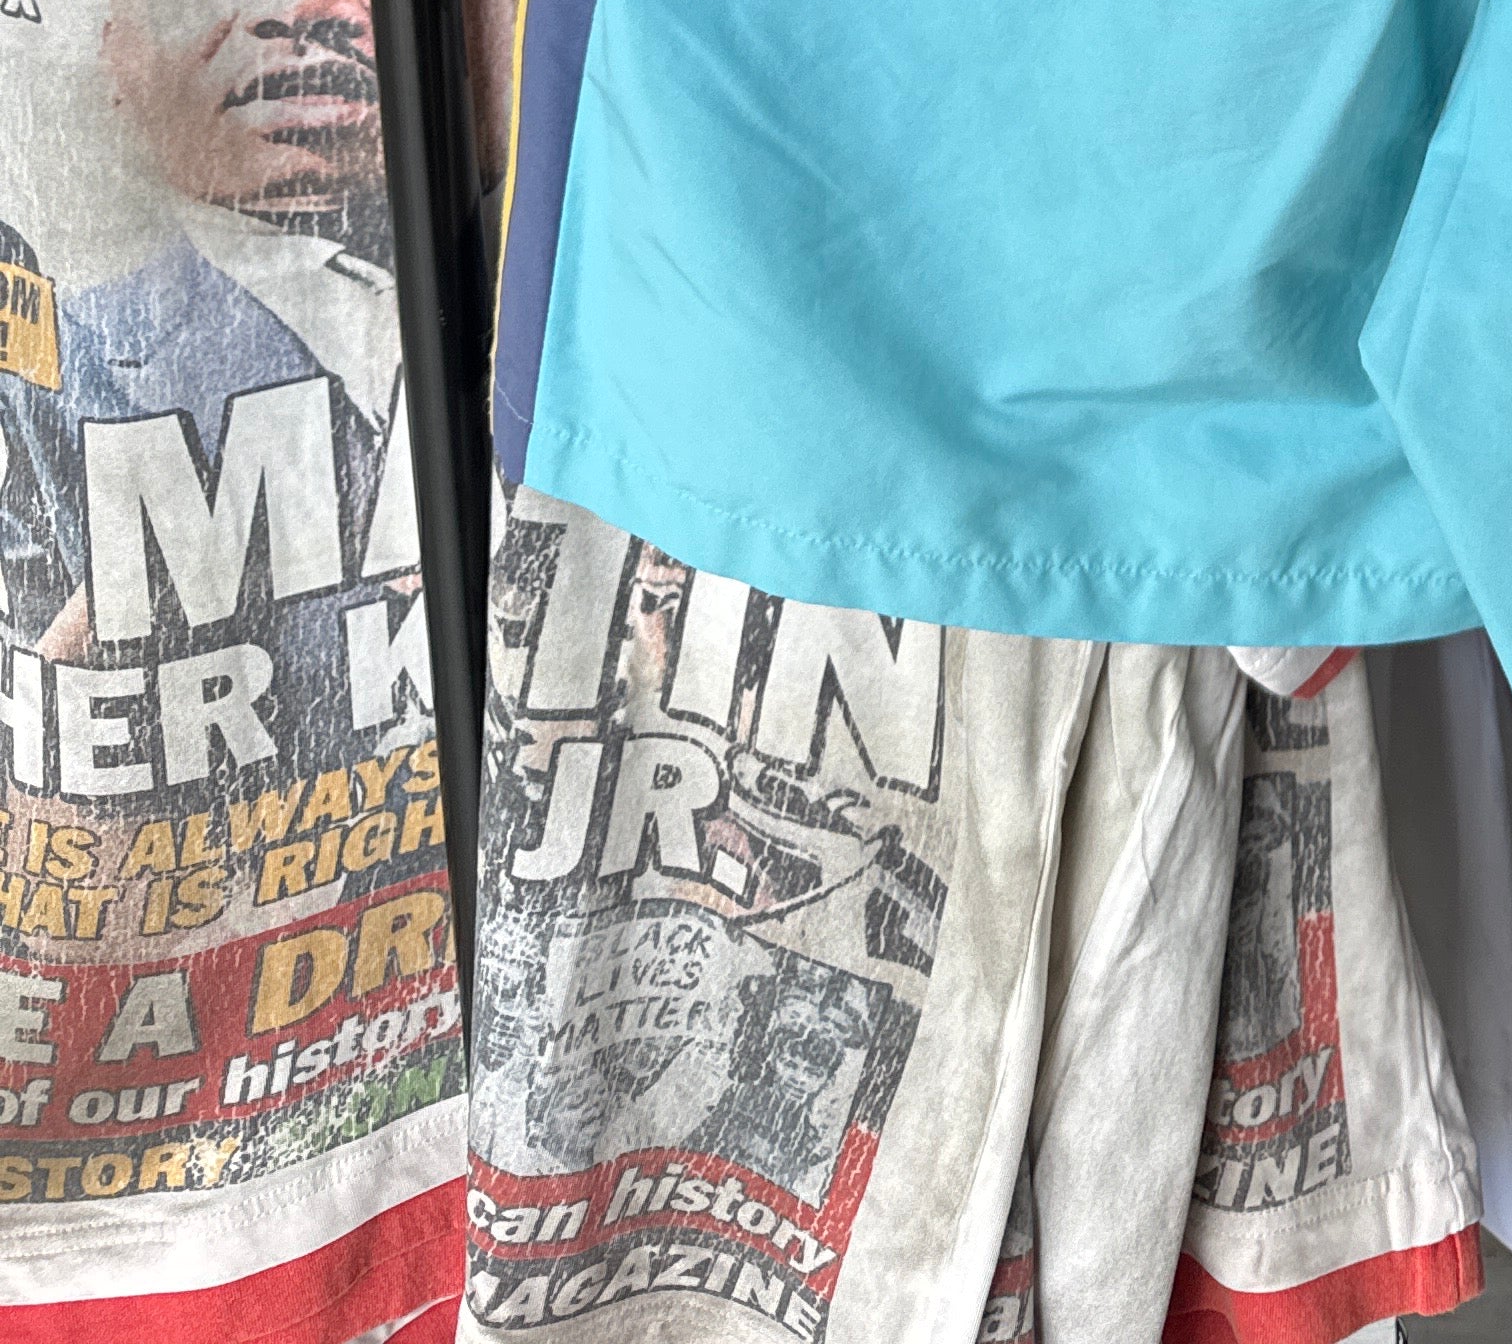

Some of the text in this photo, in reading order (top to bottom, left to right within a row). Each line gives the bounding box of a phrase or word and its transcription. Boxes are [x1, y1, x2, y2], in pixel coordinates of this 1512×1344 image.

[120, 739, 441, 880] ALWAYS
[101, 971, 199, 1062] A
[68, 1077, 200, 1125] our
[603, 1162, 839, 1275] history
